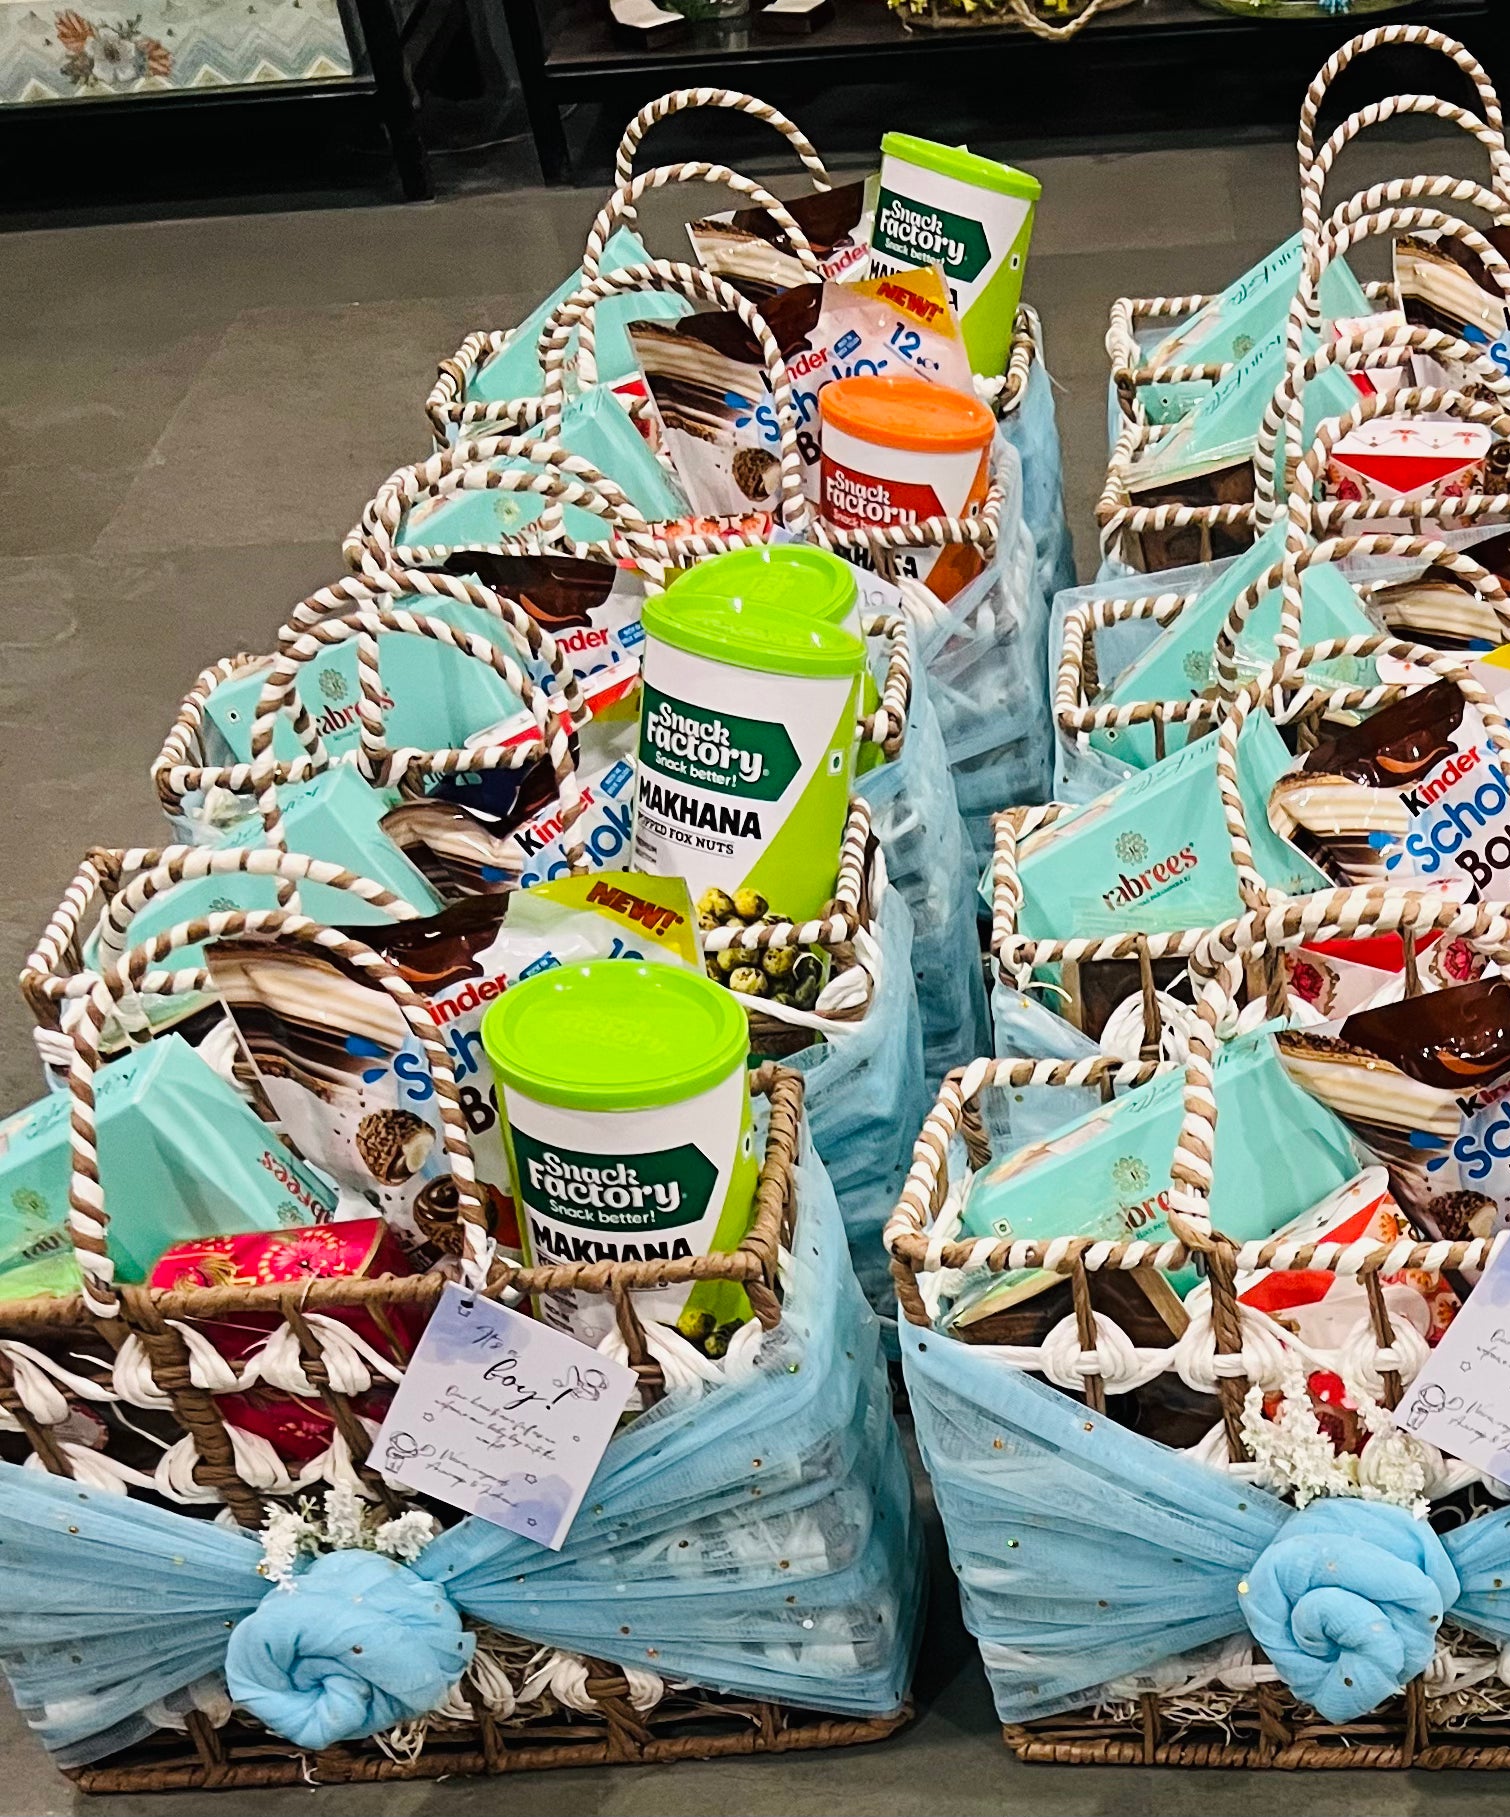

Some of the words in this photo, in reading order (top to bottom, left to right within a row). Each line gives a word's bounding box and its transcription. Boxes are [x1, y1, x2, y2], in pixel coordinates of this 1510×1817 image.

[880, 207, 965, 266] Factory
[891, 200, 942, 233] Snack
[876, 282, 944, 323] NEW!
[835, 470, 891, 505] Snack
[659, 702, 730, 744] Snack
[646, 711, 763, 783] Factory
[655, 751, 687, 775] Snack
[690, 763, 737, 788] better!
[1400, 745, 1481, 818] Kinder
[639, 775, 762, 841] MAKHANA
[669, 827, 692, 846] FOX
[695, 835, 735, 856] NUTS
[1103, 846, 1198, 911] rabrees
[586, 880, 684, 935] NEW!
[527, 1156, 682, 1213] Factory
[543, 1151, 638, 1186] Snack
[549, 1199, 596, 1221] Snack
[598, 1209, 656, 1224] better!
[531, 1217, 694, 1264] MAKHANA
[483, 1358, 573, 1410] boy!
